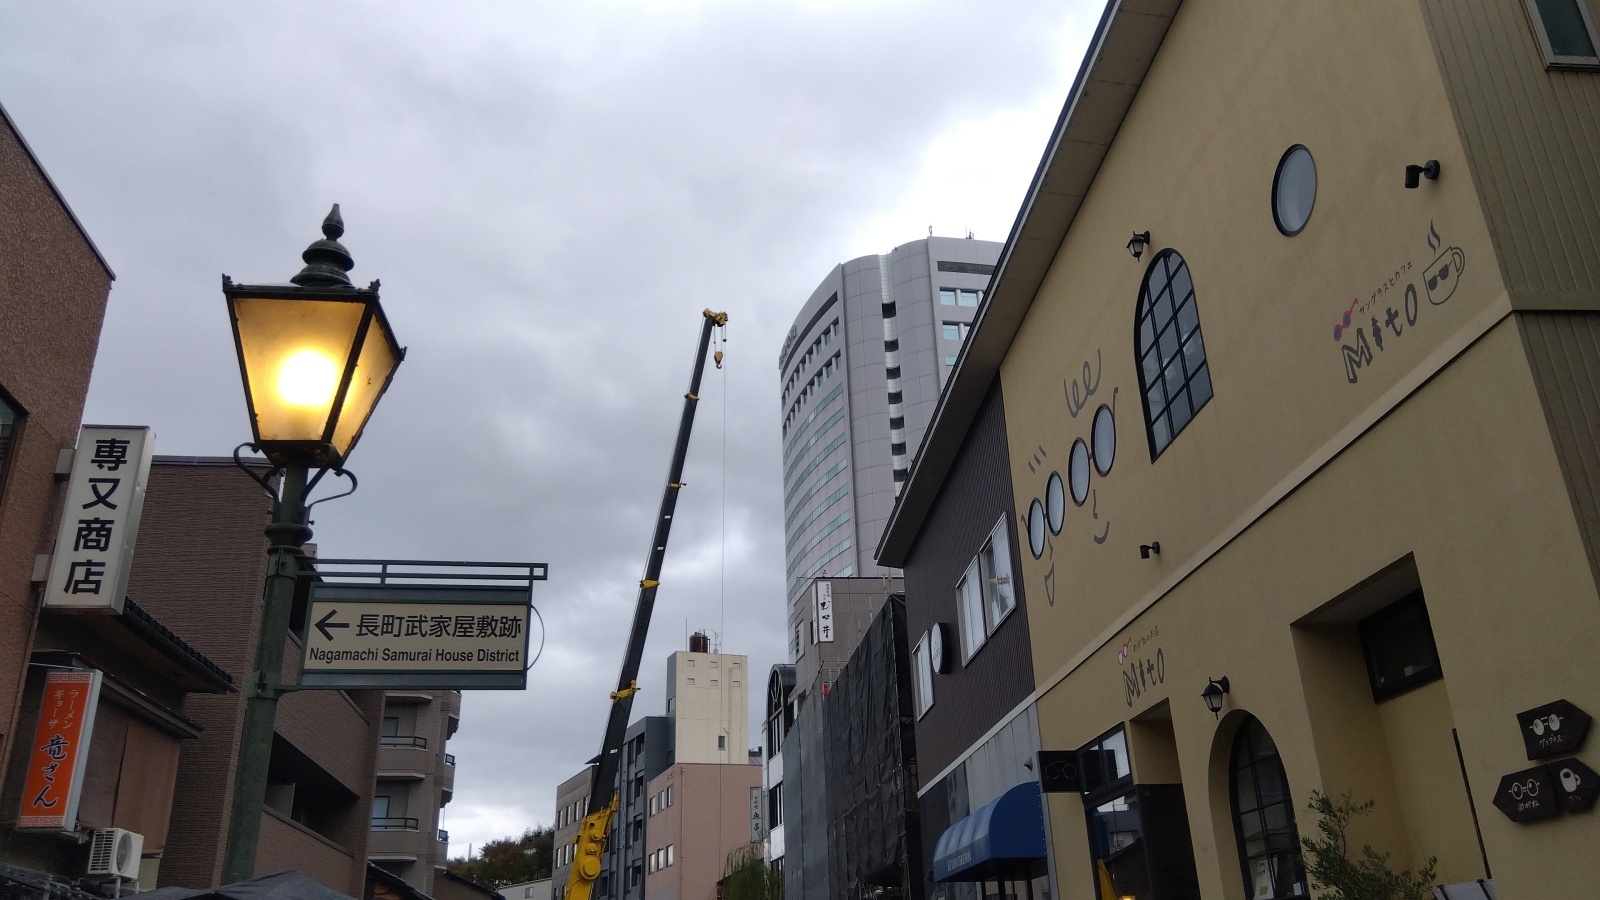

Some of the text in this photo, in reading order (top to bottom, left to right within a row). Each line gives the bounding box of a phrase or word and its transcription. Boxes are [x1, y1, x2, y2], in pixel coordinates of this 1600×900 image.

[1359, 261, 1413, 315] サングラスとカフェ
[63, 438, 131, 595] 専又商店
[356, 614, 523, 639] 長町武家屋敷跡
[309, 647, 520, 664] Nagamachi Samurai House District
[48, 689, 65, 730] ギョーザ
[63, 689, 80, 730] ラーメン
[32, 733, 69, 809] 竜さん
[1517, 799, 1540, 812] めがね
